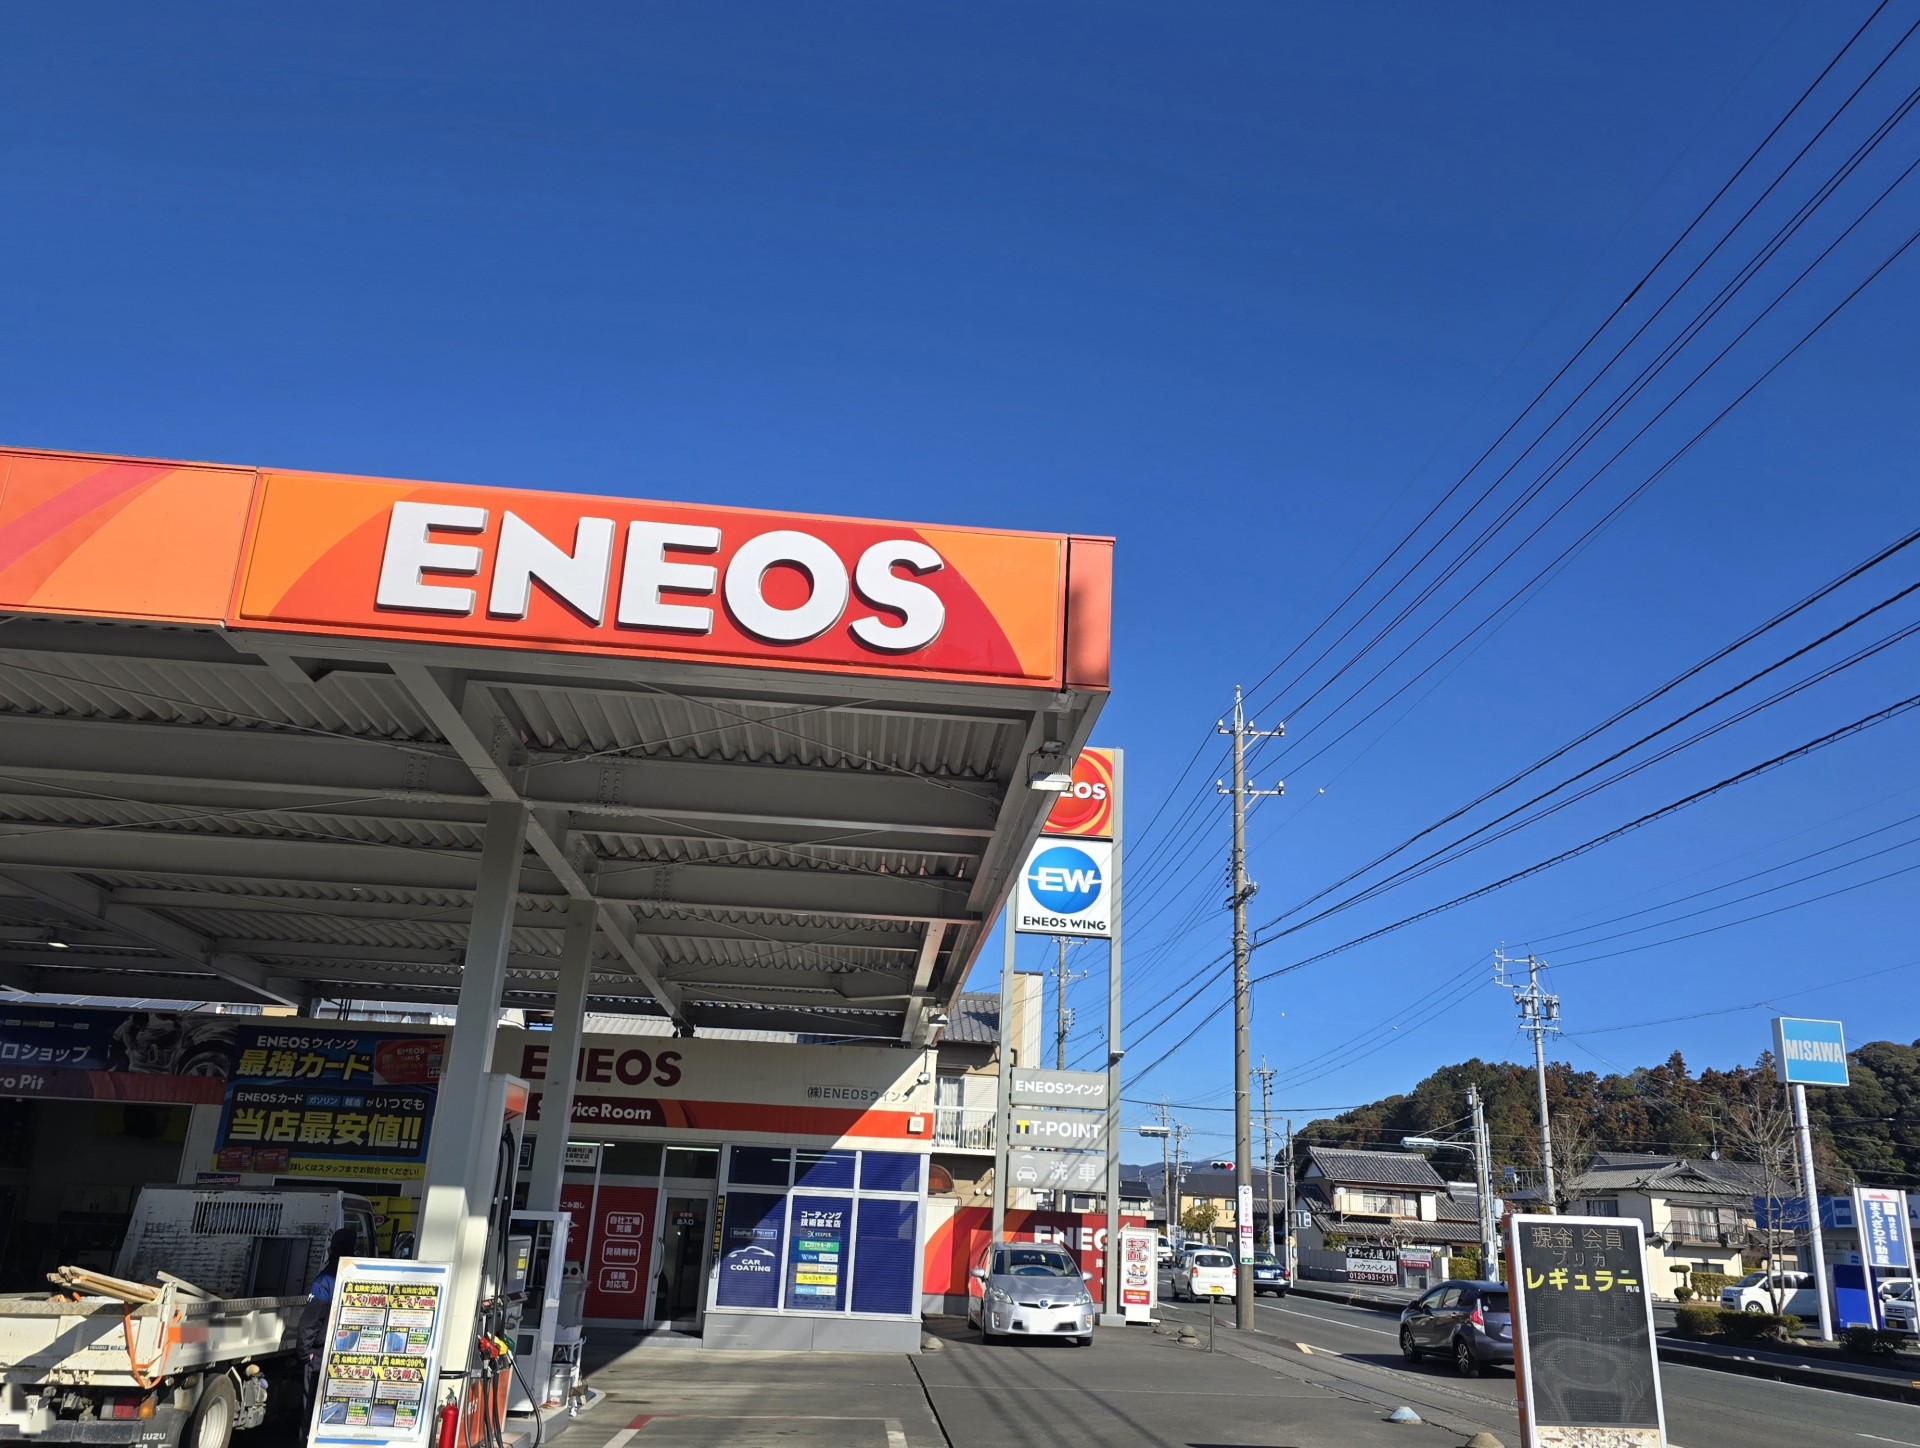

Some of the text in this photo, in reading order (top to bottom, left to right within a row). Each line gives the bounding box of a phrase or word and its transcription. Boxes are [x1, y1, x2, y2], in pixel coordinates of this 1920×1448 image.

[376, 501, 946, 656] ENEOS
[1038, 866, 1095, 893] EW
[1023, 915, 1107, 931] ENEOS WING
[0, 1040, 91, 1063] ロショップ
[1784, 1038, 1843, 1063] MISAWA
[236, 1049, 371, 1080] 最強カード
[520, 1044, 683, 1087] EEOS
[18, 1073, 45, 1090] Pit
[1015, 1080, 1104, 1096] ENEOSウイング
[236, 1092, 304, 1105] ENEOSカード
[366, 1097, 425, 1111] がいつでも
[600, 1103, 652, 1120] Room
[1030, 1120, 1102, 1139] T-POINT
[609, 1216, 641, 1226] 自社工場
[676, 1218, 694, 1226] 出入口
[800, 1218, 842, 1228] 技術認定店
[801, 1210, 843, 1220] コーティング
[1868, 1202, 1890, 1265] まえざわ不動産
[1887, 1216, 1899, 1242] 株式会社
[1126, 1237, 1150, 1251] キズ
[1531, 1226, 1624, 1251] 現金 会員
[606, 1247, 637, 1257] 見積無料
[1126, 1249, 1149, 1262] 直し
[730, 1264, 772, 1272] COATING
[741, 1258, 761, 1266] CAR
[1353, 1262, 1394, 1273] ハウスペイント
[1349, 1272, 1394, 1282] 0120-931-215
[1525, 1267, 1638, 1293] レギュラー
